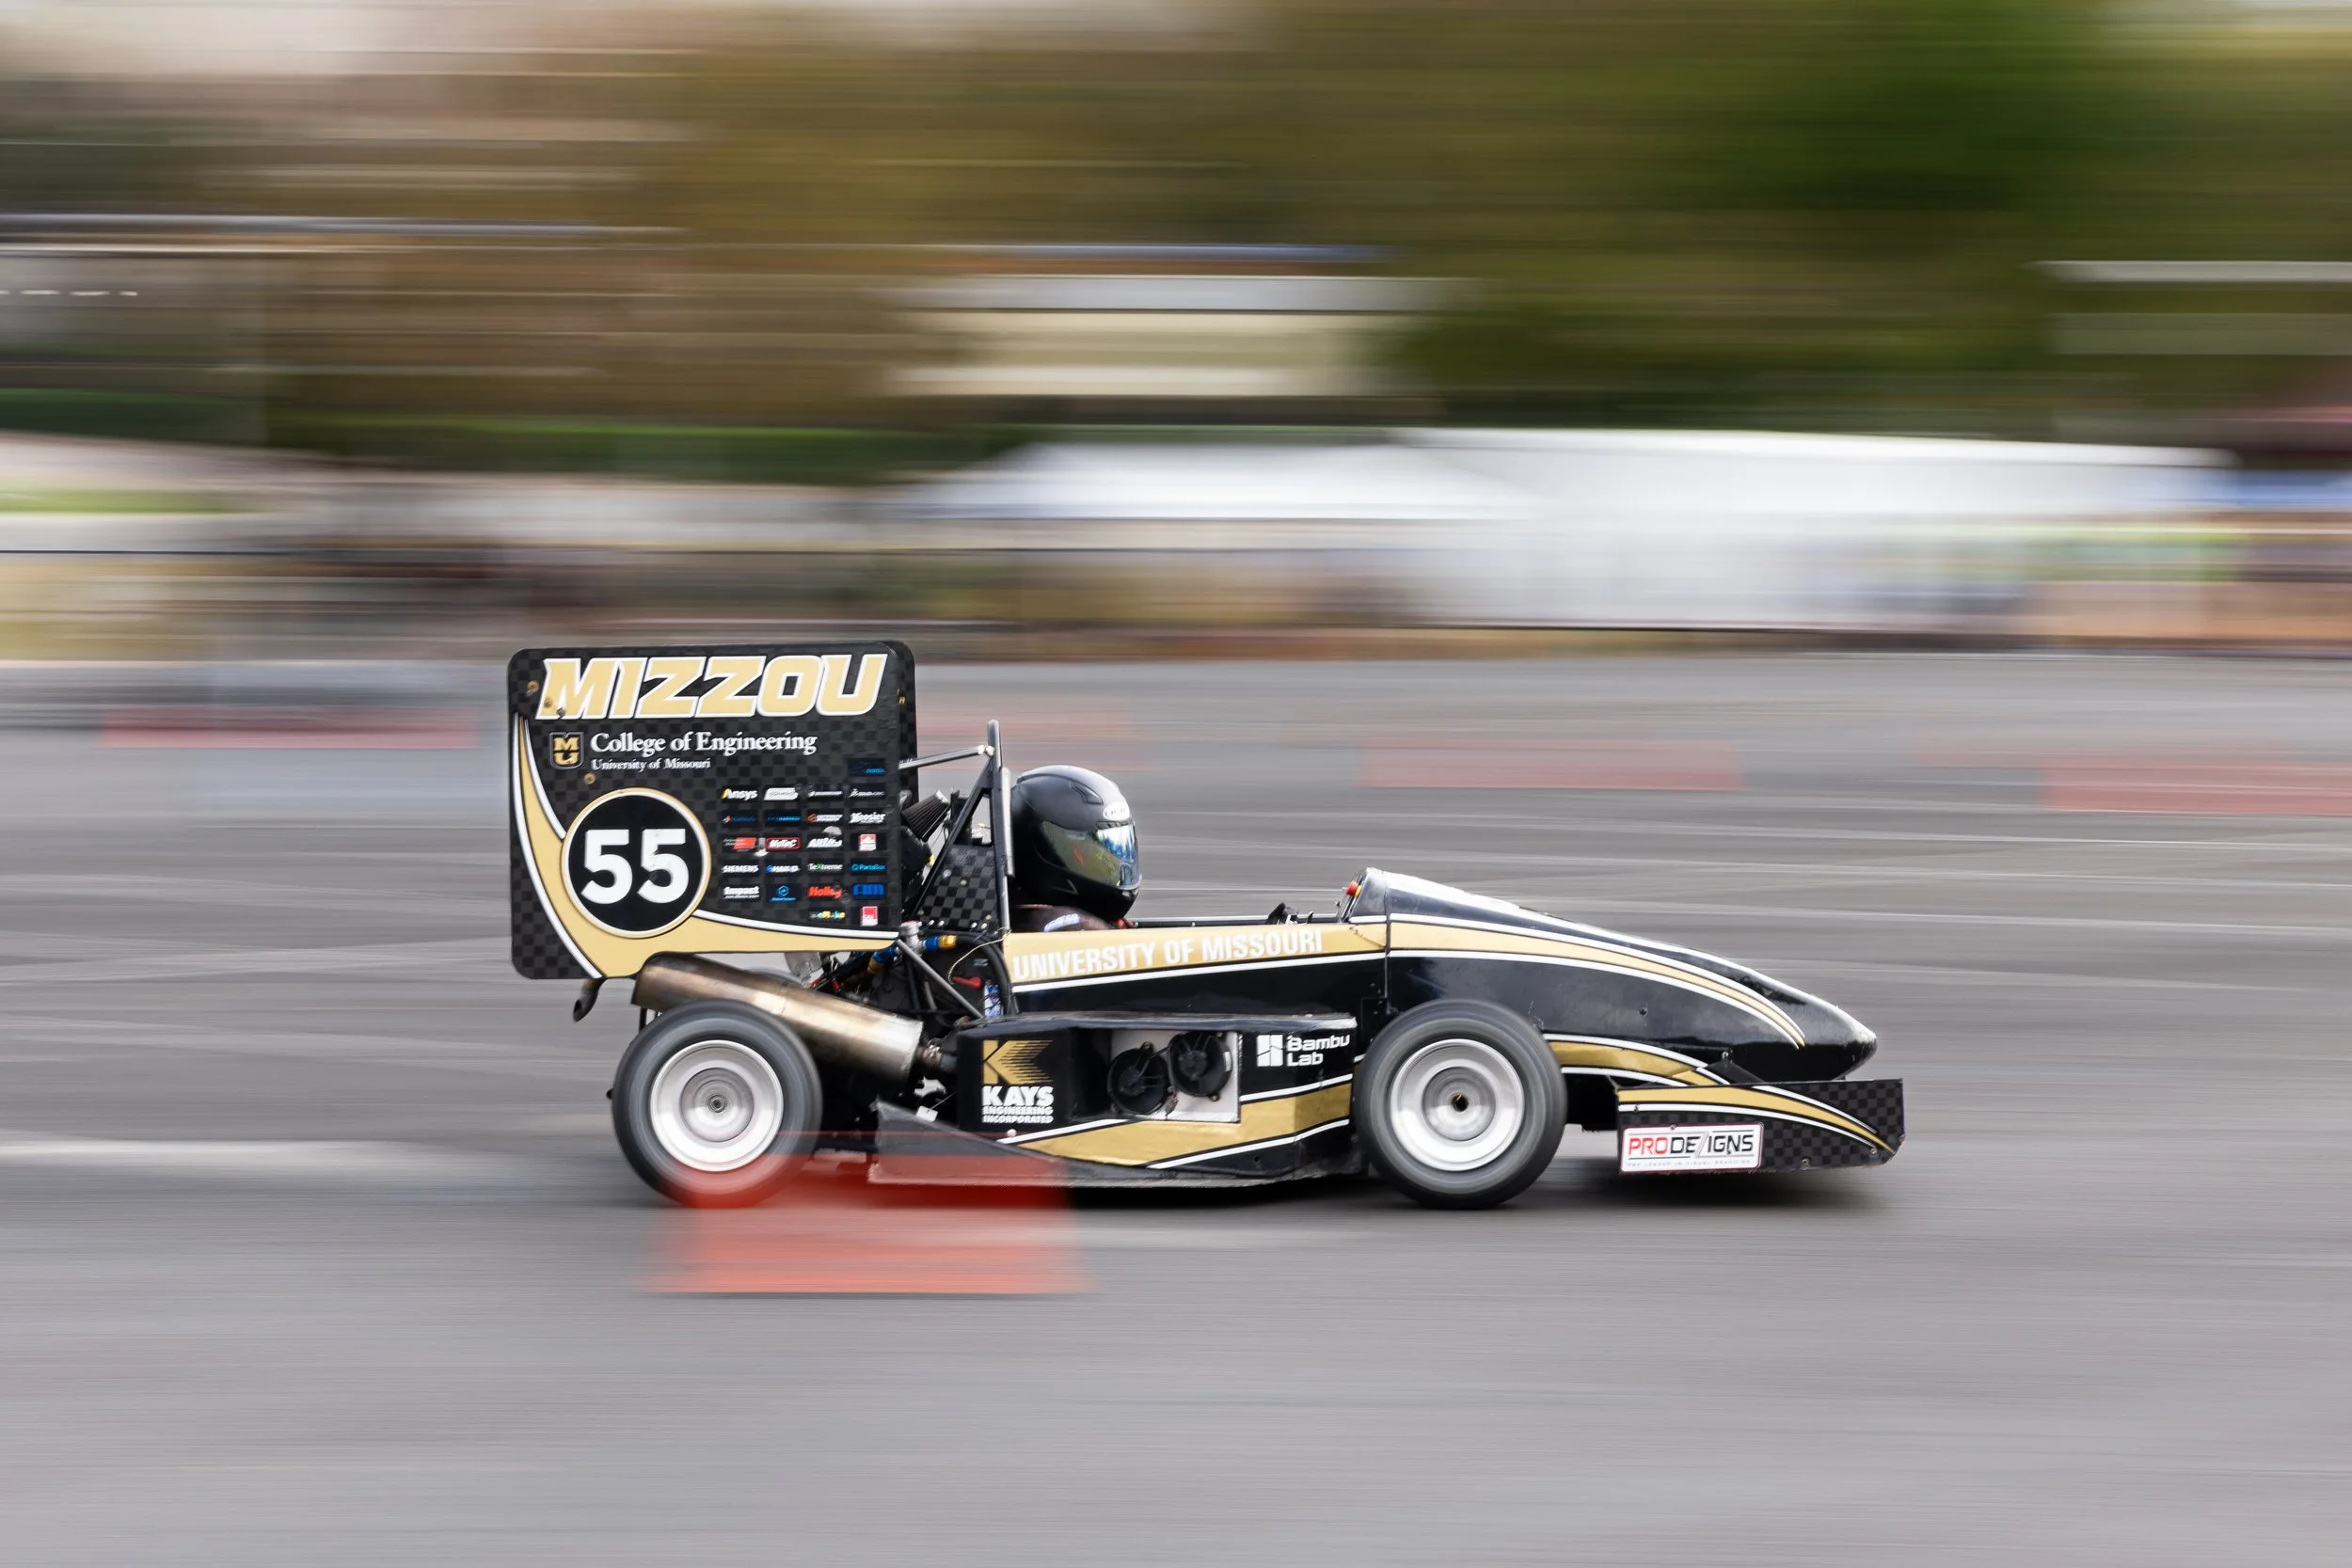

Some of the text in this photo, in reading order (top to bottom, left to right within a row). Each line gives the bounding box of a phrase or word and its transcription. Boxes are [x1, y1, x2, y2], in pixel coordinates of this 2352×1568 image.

[535, 654, 888, 720] MIZZOU
[590, 731, 818, 758] College of Engineering
[591, 757, 711, 772] University of Missouri
[722, 788, 758, 800] Ansys
[581, 828, 689, 905] 55
[722, 864, 759, 873] SIEMENS
[1012, 929, 1323, 980] UNIVERSITY OF MISSOURI
[1286, 1034, 1350, 1052] Bambu
[1286, 1052, 1324, 1067] Lab
[982, 1085, 1054, 1106] KAYS
[982, 1106, 1054, 1115] ENGINEERING
[982, 1115, 1055, 1124] INCORPORATED
